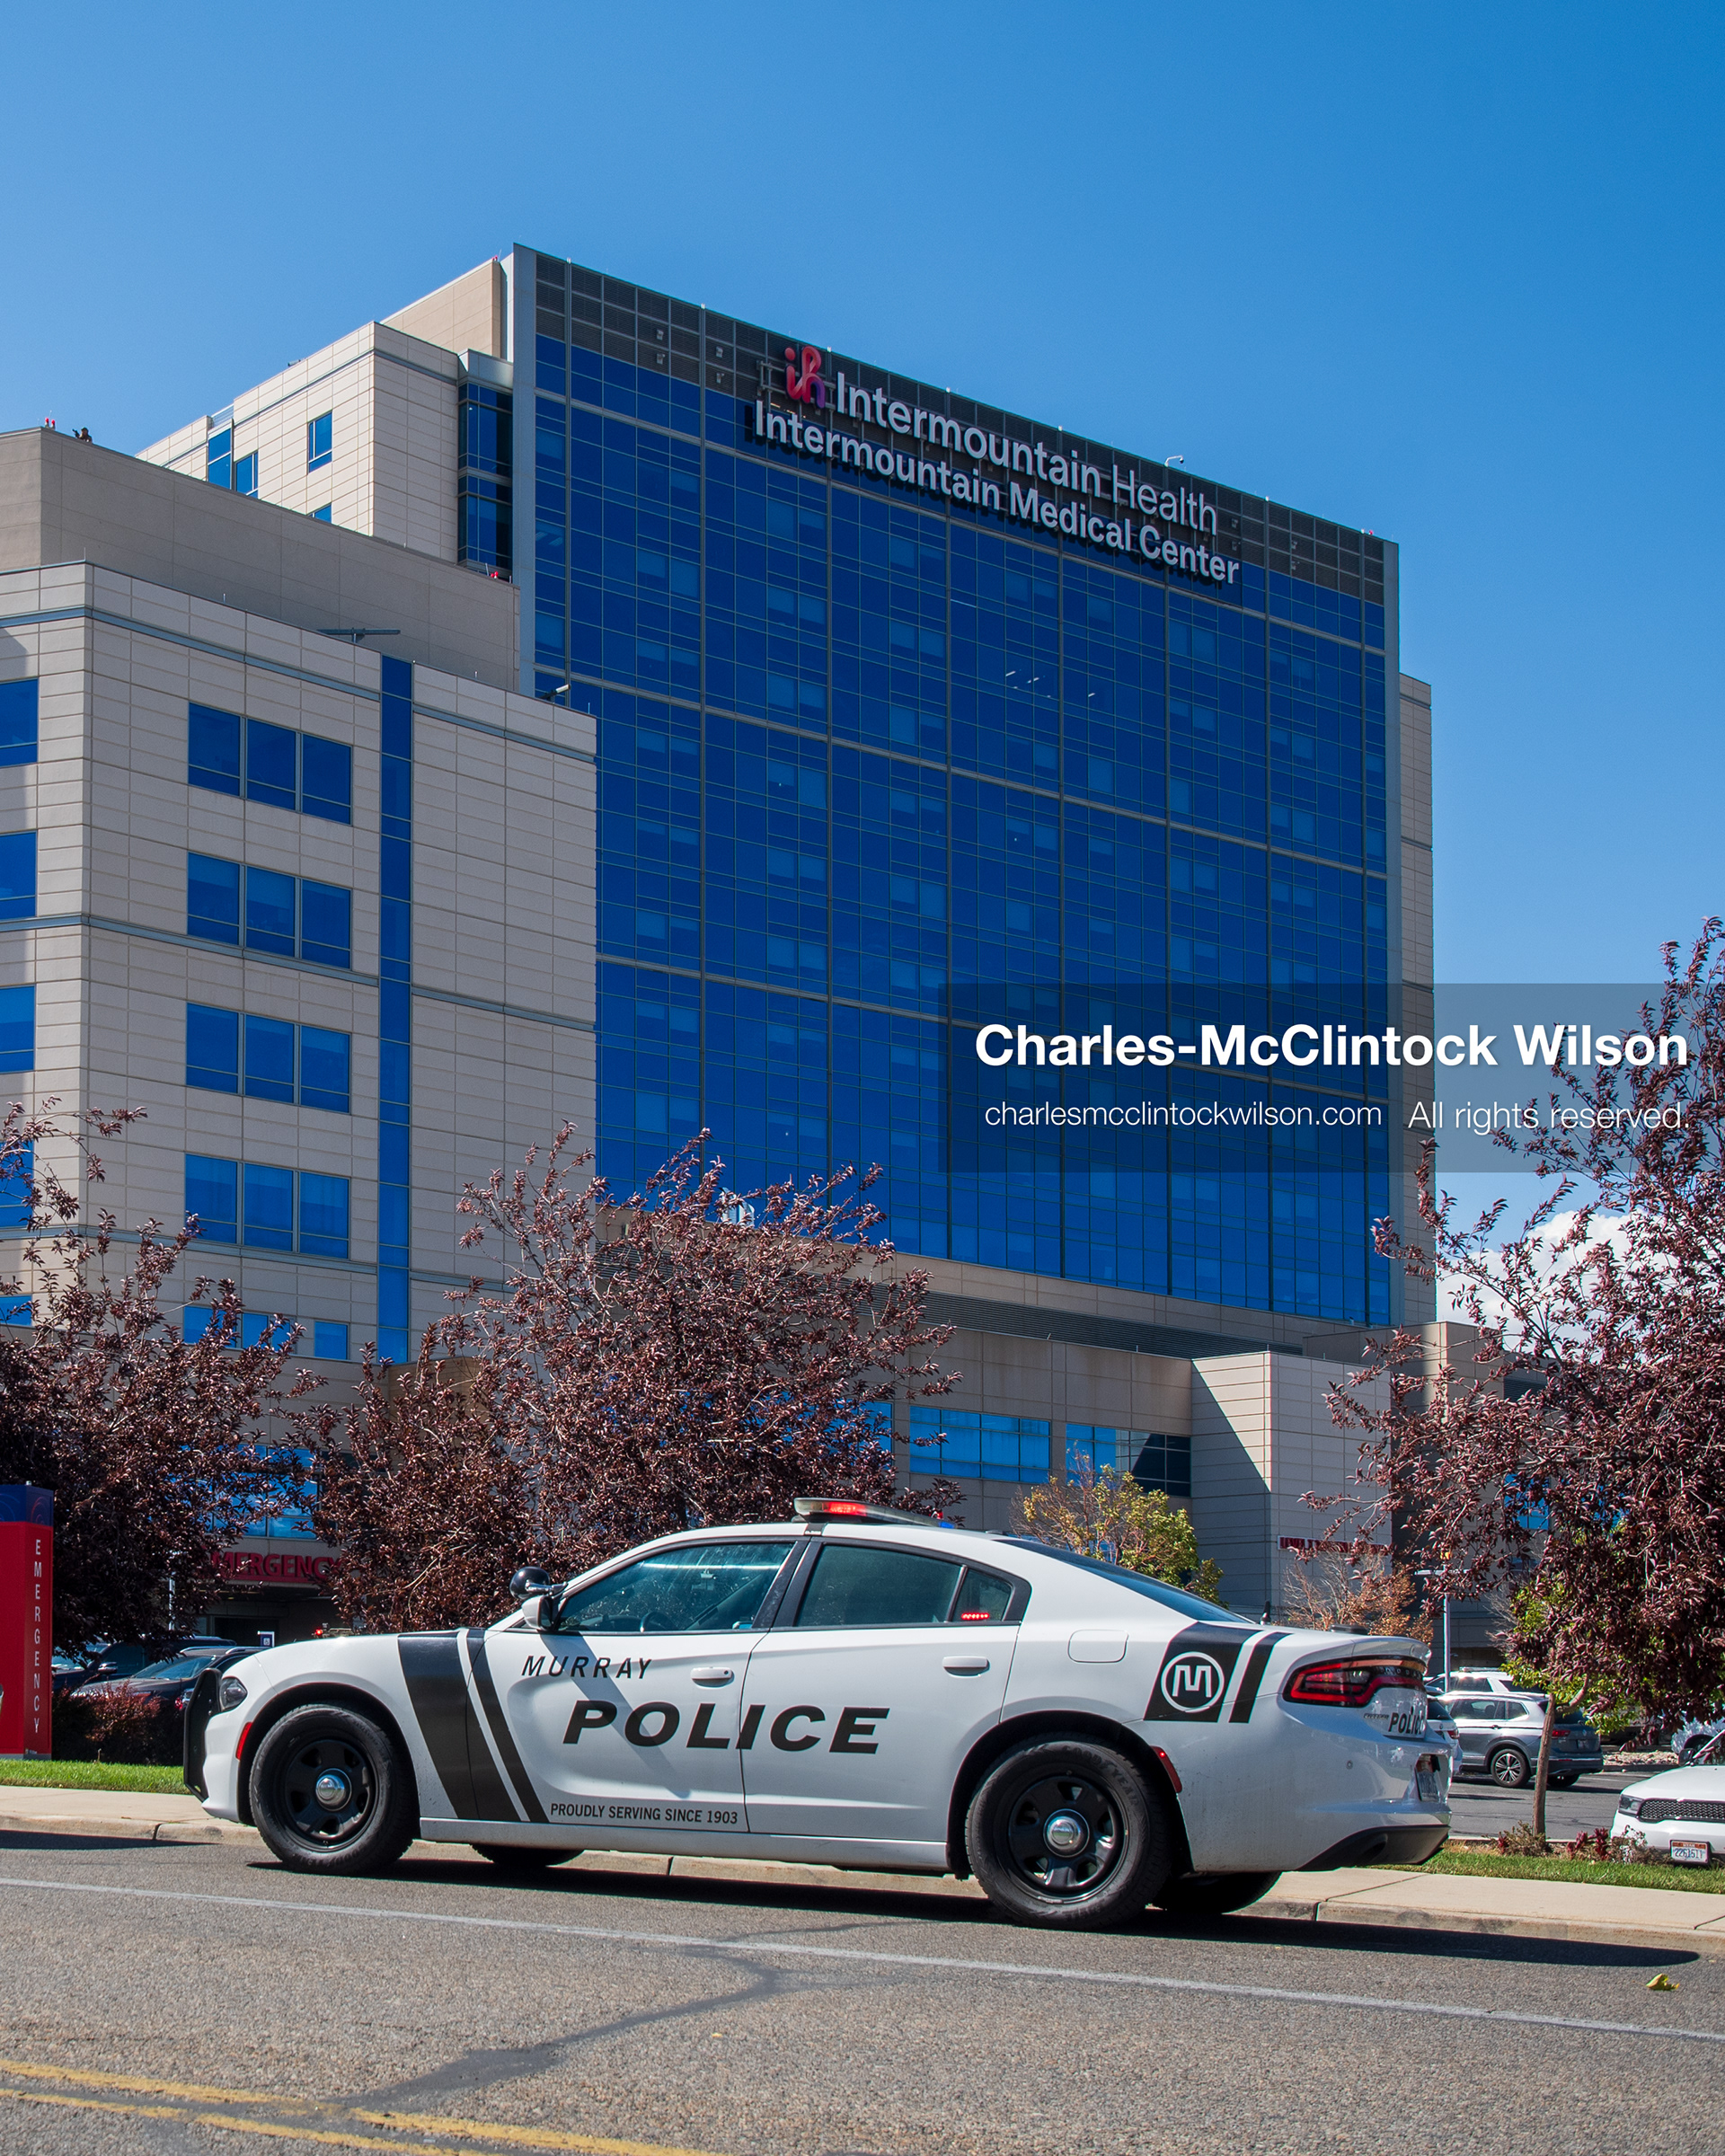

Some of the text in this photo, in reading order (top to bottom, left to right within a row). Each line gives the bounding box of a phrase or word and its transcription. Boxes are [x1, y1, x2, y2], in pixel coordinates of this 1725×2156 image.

[836, 371, 1101, 497] Intermountain
[1112, 464, 1216, 536] Health
[756, 400, 1239, 584] Intermountain Medical Center
[206, 1551, 341, 1579] MERGENCY
[33, 1538, 42, 1735] EMERGENCY
[521, 1655, 651, 1679] MURRAY
[562, 1700, 890, 1754] POLICE
[551, 1803, 739, 1825] PROUDLY SERVING SINCE 1903
